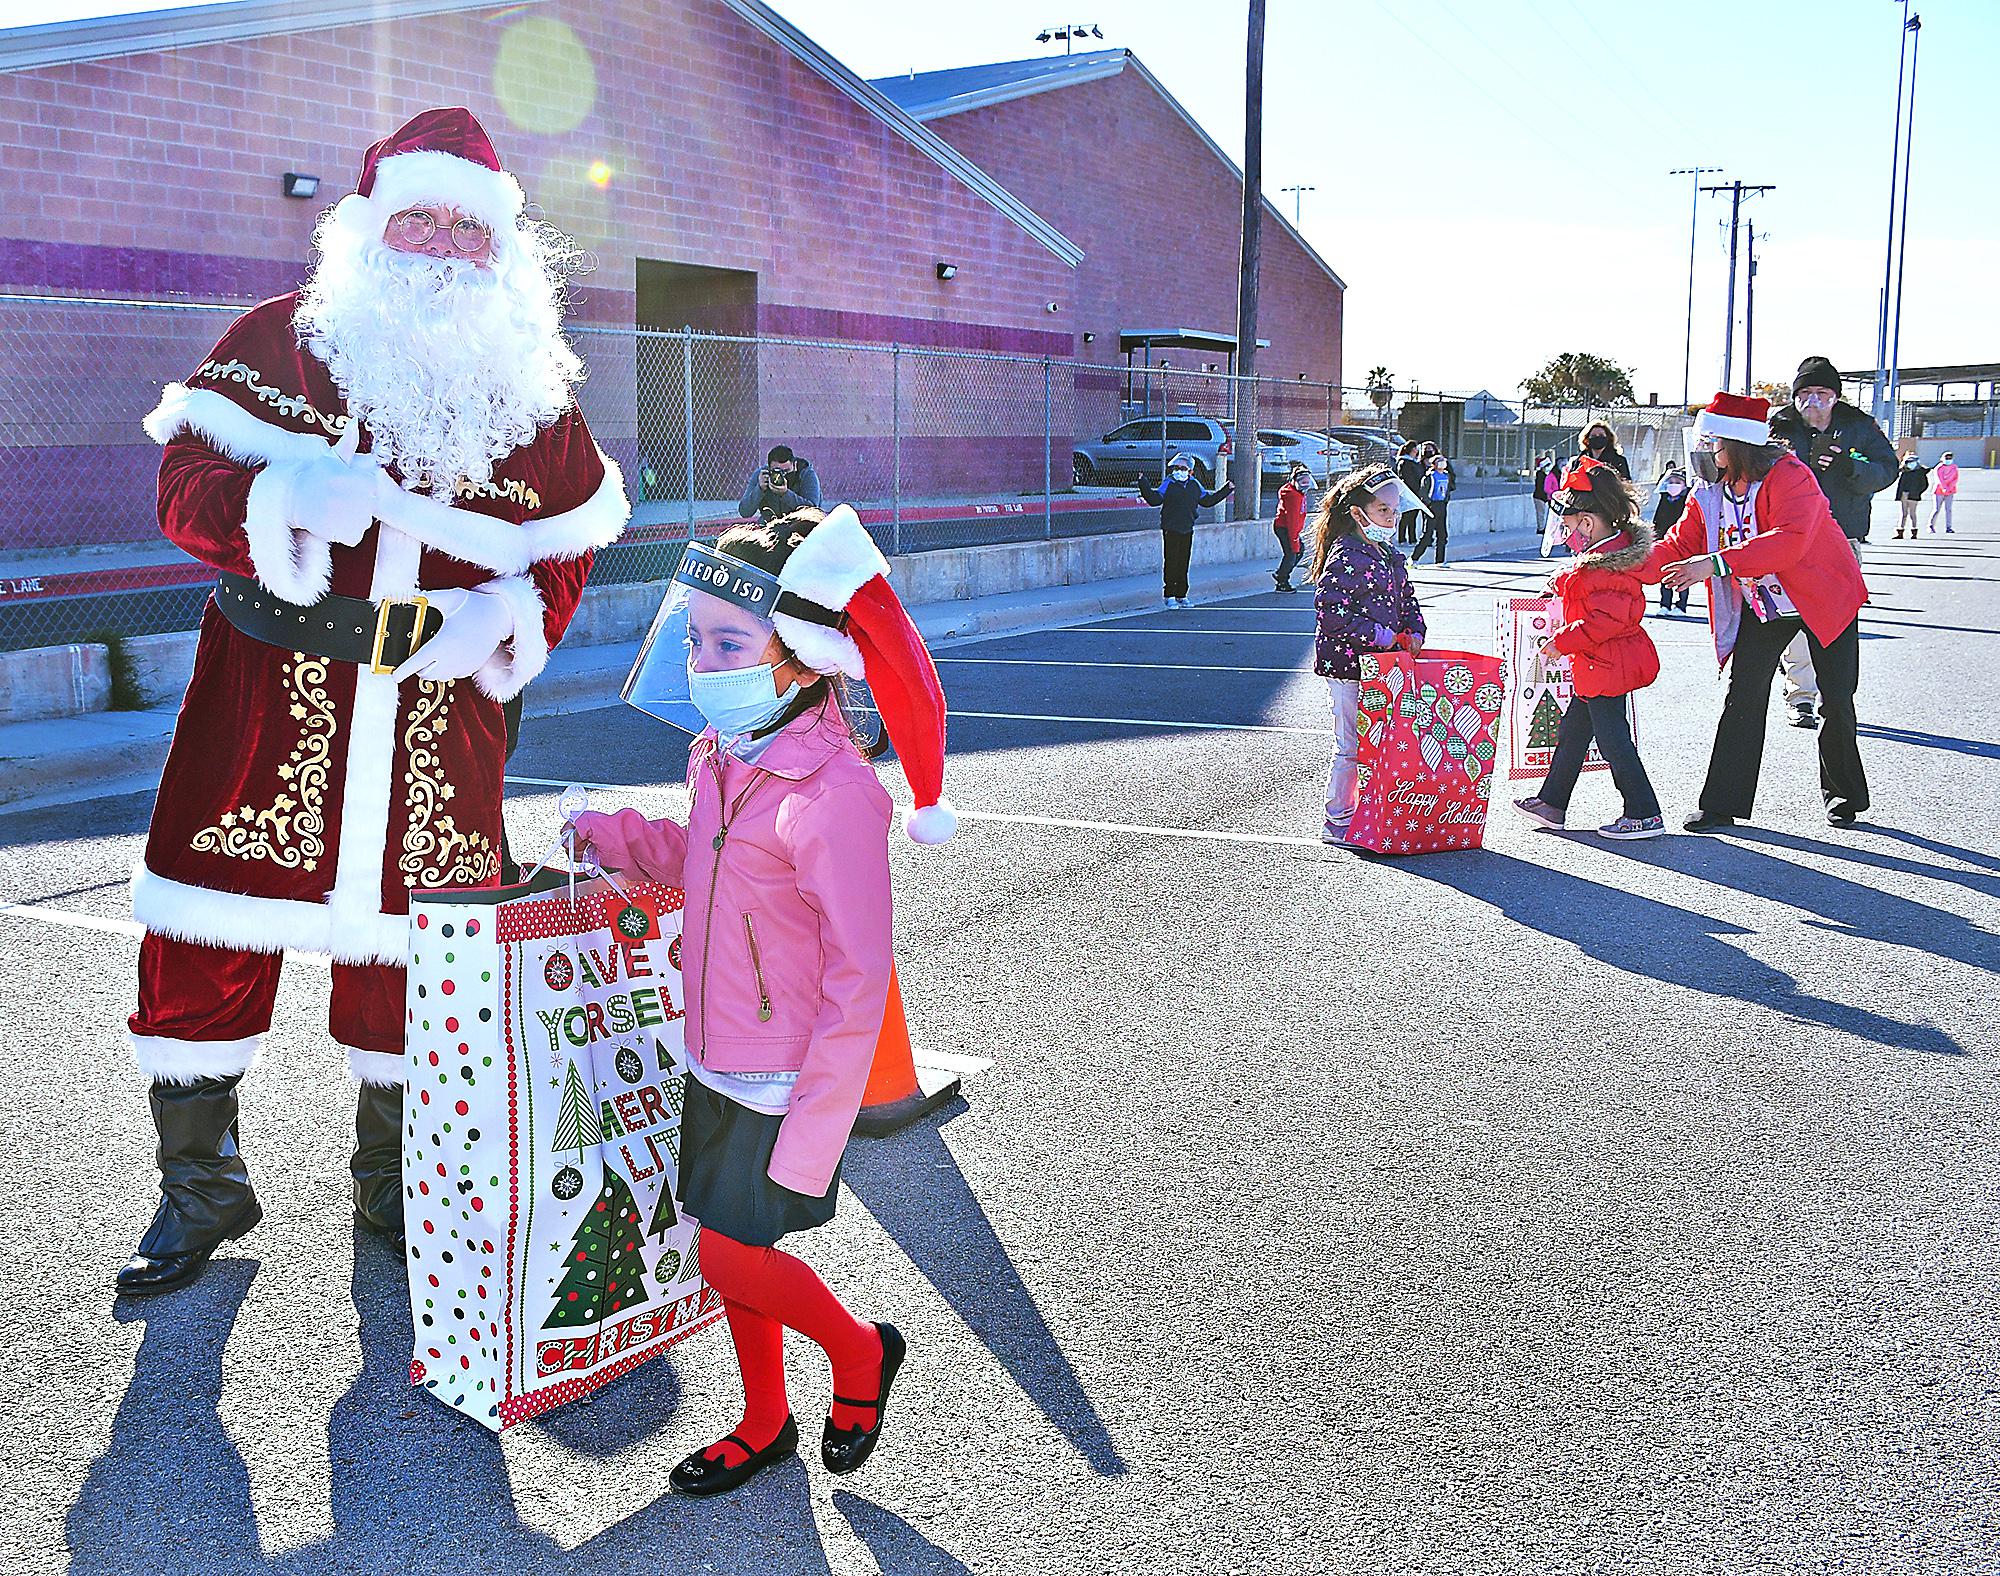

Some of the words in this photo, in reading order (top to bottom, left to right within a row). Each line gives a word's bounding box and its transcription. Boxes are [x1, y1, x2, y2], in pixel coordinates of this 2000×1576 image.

[10, 578, 43, 592] LANE
[731, 578, 765, 602] ISD
[1387, 778, 1439, 817] Happy
[576, 941, 653, 988] AVE
[536, 986, 685, 1051] YORSEL
[600, 1074, 688, 1142] MERR
[537, 1287, 722, 1373] CHRISTMA
